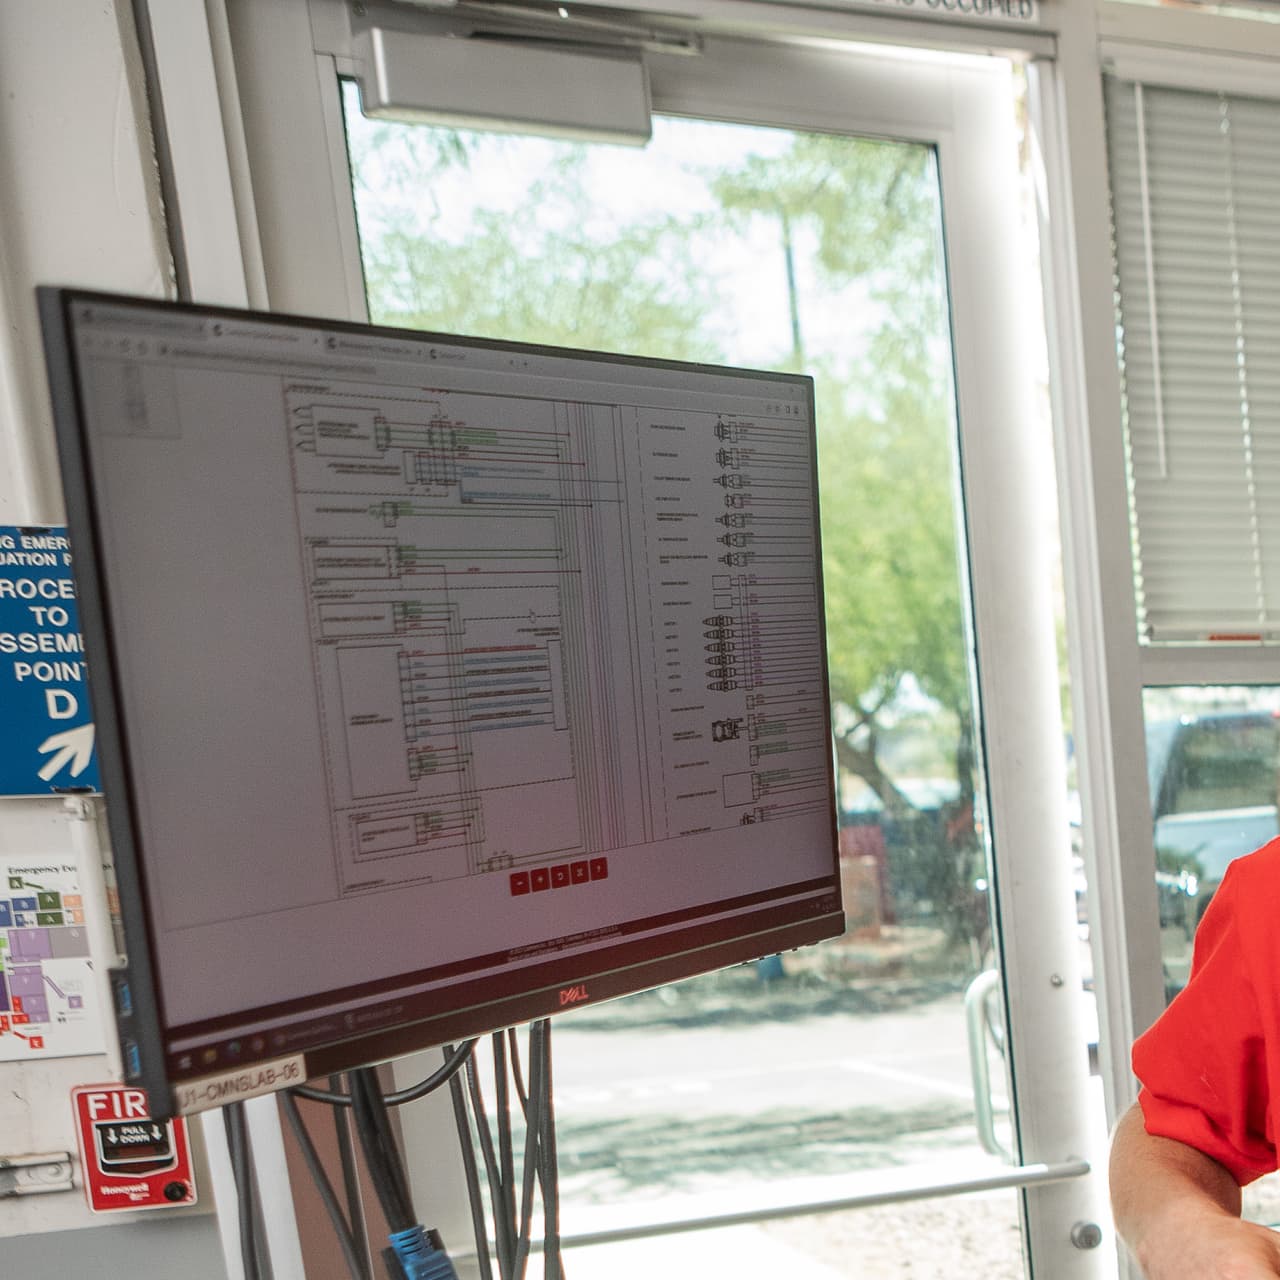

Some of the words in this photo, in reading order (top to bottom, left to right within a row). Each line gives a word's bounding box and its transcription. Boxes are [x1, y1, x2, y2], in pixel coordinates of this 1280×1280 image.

[21, 535, 71, 550] EMER
[0, 578, 78, 600] ROCE
[28, 605, 69, 627] TO
[45, 688, 79, 719] D
[560, 984, 589, 1005] DELL
[86, 1091, 148, 1120] FIR
[120, 1134, 150, 1144] DOWN
[121, 1127, 147, 1135] PULL
